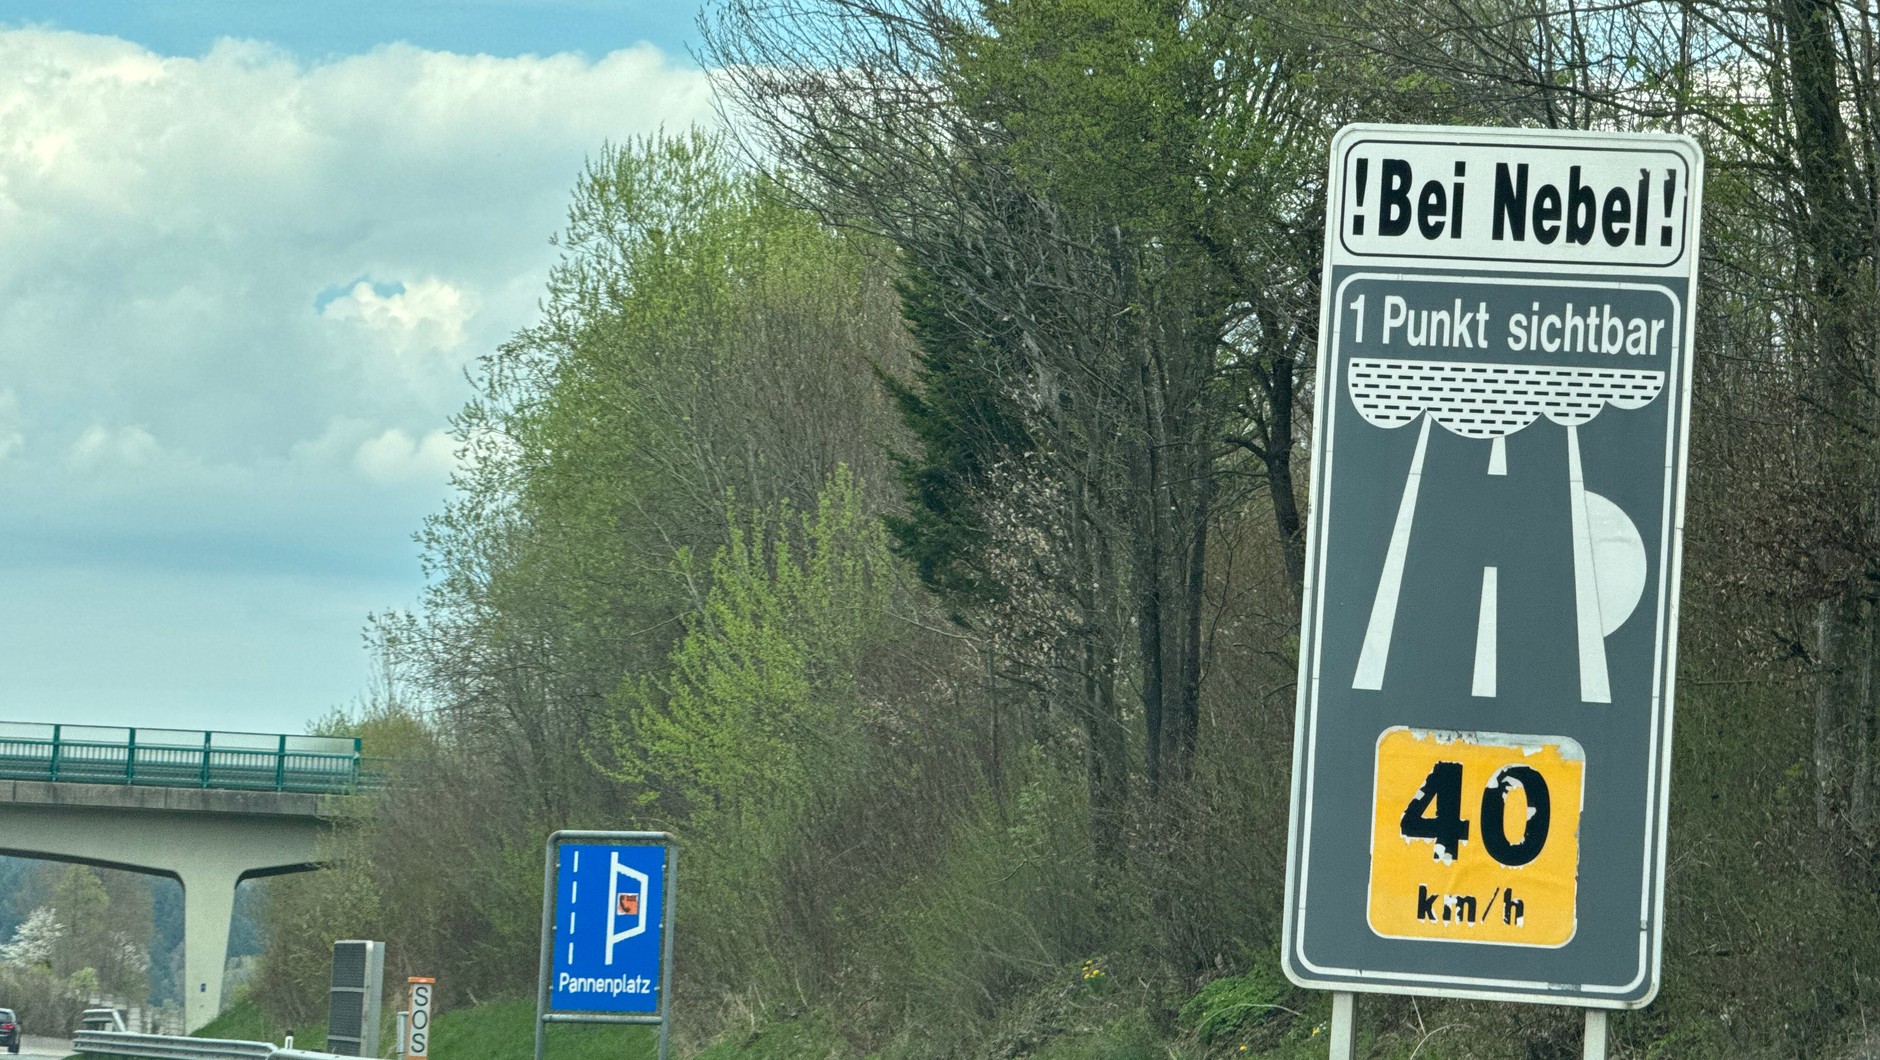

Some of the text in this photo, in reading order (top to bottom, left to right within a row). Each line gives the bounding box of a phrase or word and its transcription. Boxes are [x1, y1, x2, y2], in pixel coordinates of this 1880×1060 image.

[1350, 294, 1665, 356] 1 Punkt sichtbar
[1400, 760, 1550, 867] 40
[1417, 883, 1524, 927] km/h
[558, 972, 651, 998] Pannenplatz
[411, 986, 429, 1053] SOS
